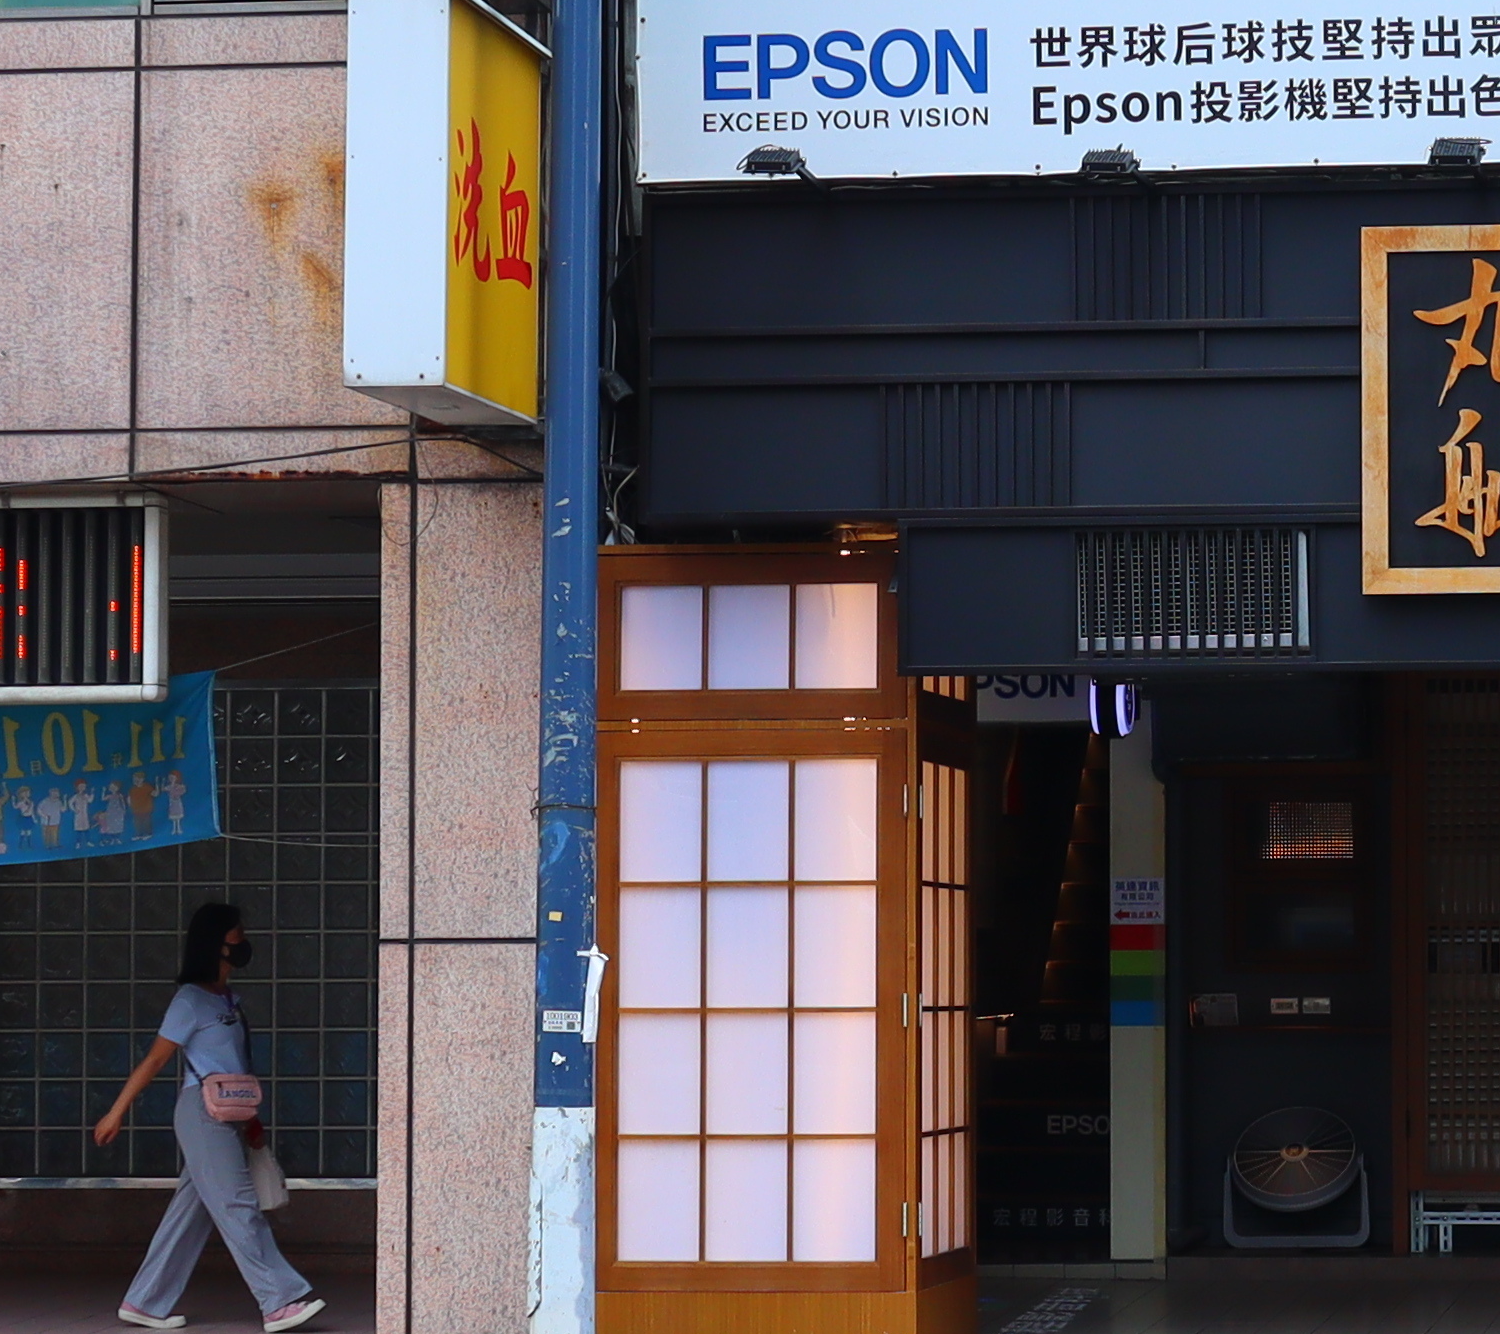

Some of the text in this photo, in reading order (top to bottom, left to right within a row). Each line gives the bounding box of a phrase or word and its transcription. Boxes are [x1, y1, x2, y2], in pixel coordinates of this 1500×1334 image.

[703, 28, 989, 101] EPSON
[703, 106, 990, 133] EXCEED YOUR VISION
[453, 117, 533, 290] 洗血
